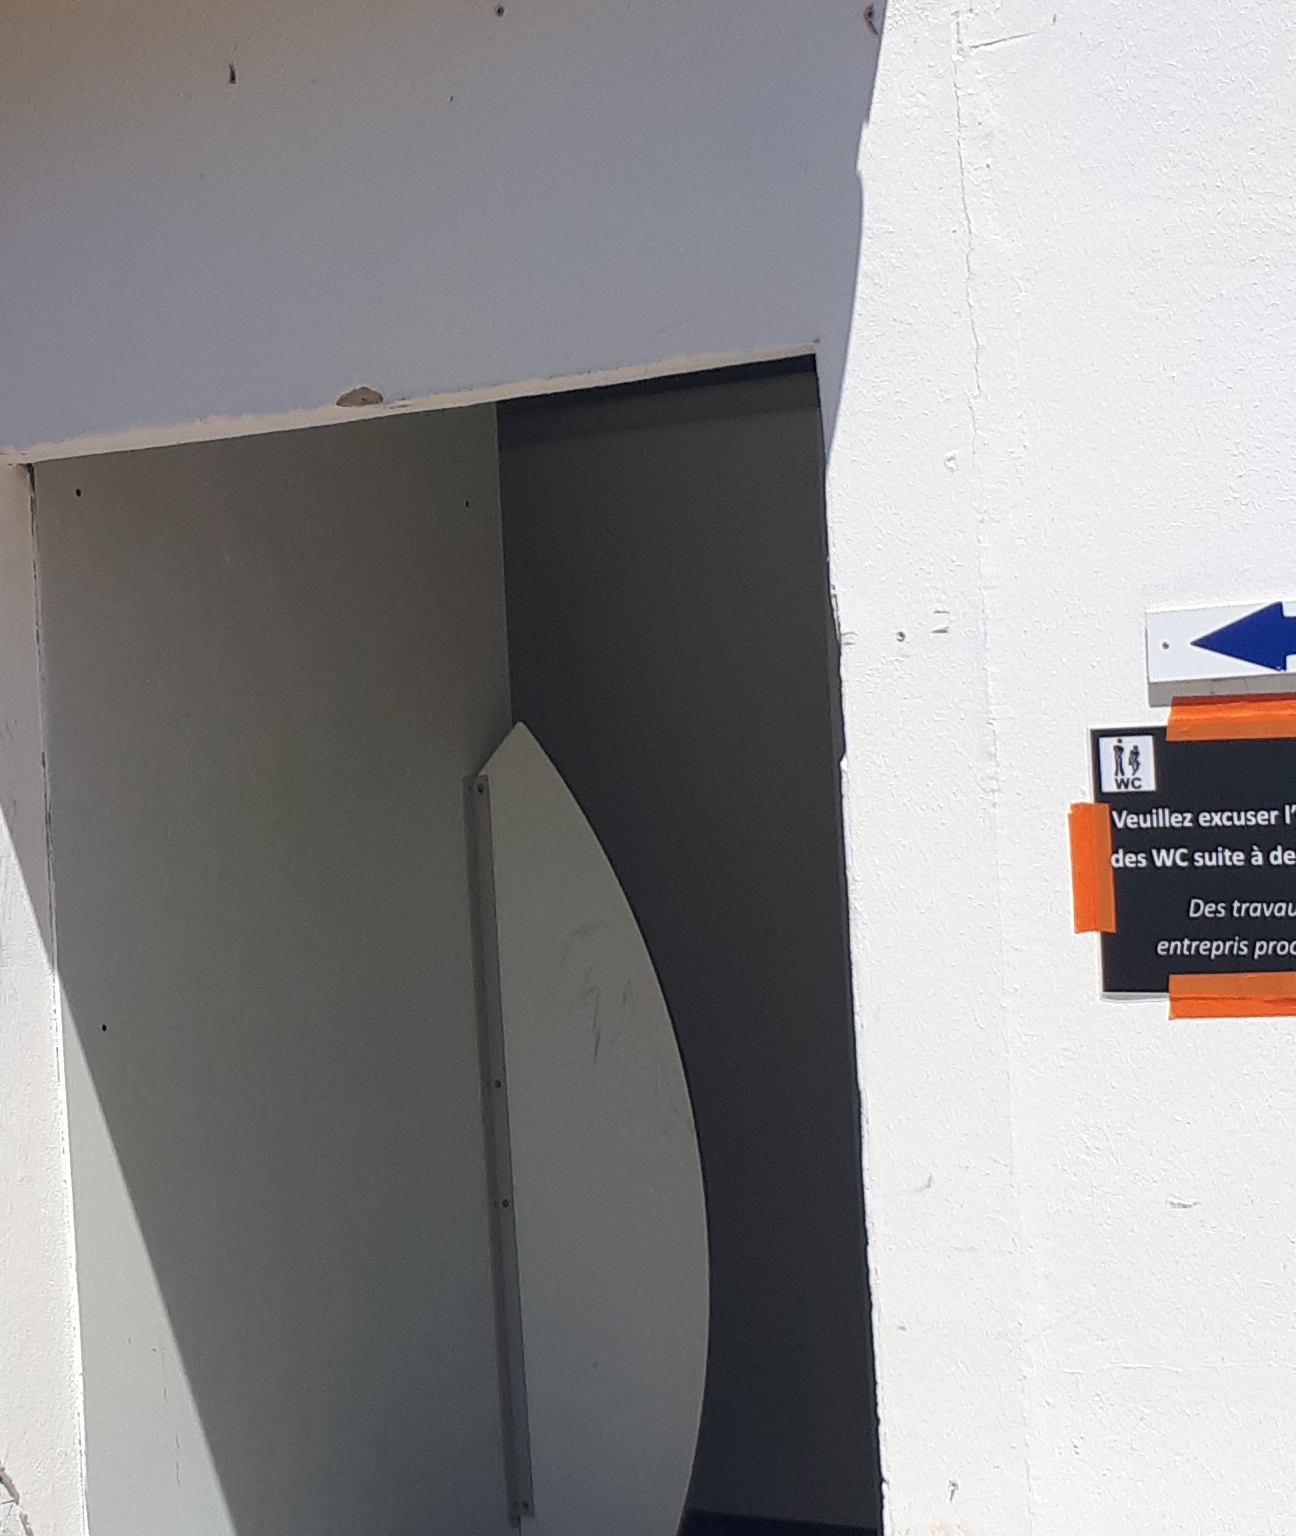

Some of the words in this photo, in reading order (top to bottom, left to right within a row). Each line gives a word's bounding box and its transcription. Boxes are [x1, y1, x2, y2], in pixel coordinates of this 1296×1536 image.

[1114, 777, 1142, 790] WC
[1112, 808, 1193, 828] Veuillez
[1198, 810, 1279, 827] excuser
[1111, 848, 1147, 867] des
[1152, 848, 1189, 867] WC
[1193, 846, 1245, 867] suite
[1250, 845, 1263, 866] à
[1189, 898, 1226, 917] Des
[1157, 935, 1248, 960] entrepris
